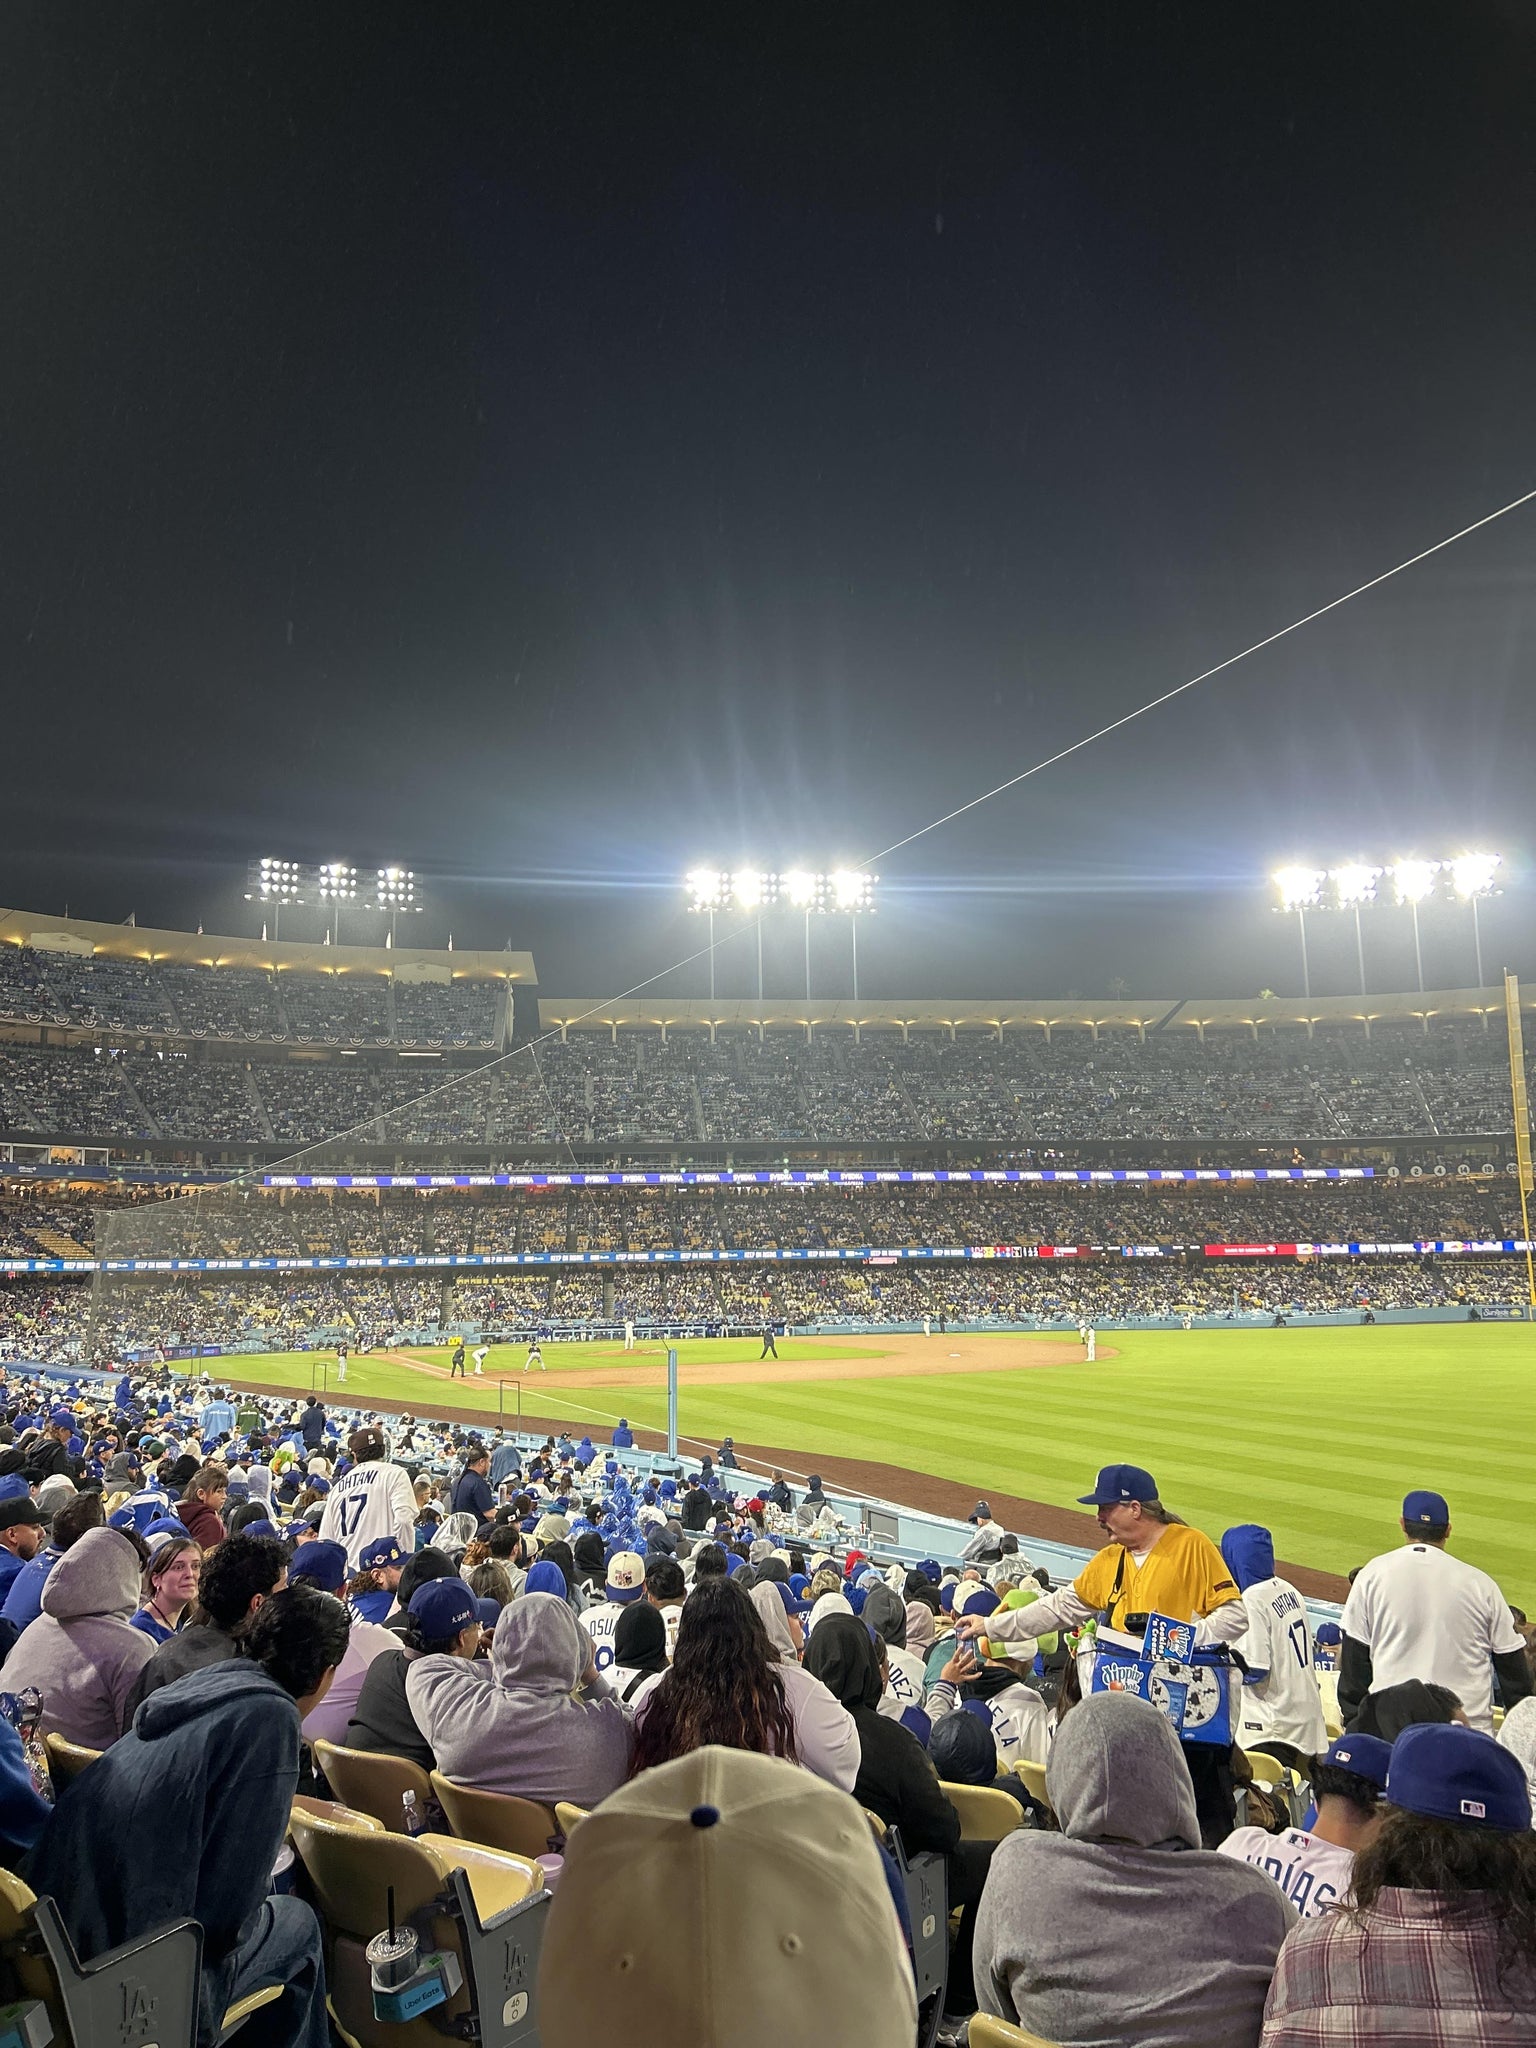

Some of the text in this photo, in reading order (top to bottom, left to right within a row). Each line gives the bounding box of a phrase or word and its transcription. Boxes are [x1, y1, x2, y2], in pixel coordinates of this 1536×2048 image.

[180, 1347, 191, 1355] blue
[338, 1470, 378, 1493] OHTANI
[340, 1493, 368, 1537] 17
[1271, 1591, 1301, 1619] OHTANI
[589, 1618, 616, 1637] OSU
[1158, 1621, 1168, 1655] Cookies
[1288, 1618, 1308, 1669] 17
[888, 1662, 914, 1700] DEZ
[1246, 1855, 1337, 1918] RÍAS
[404, 1994, 421, 2010] Uber
[422, 1985, 441, 2001] Eats
[511, 1997, 520, 2008] 46
